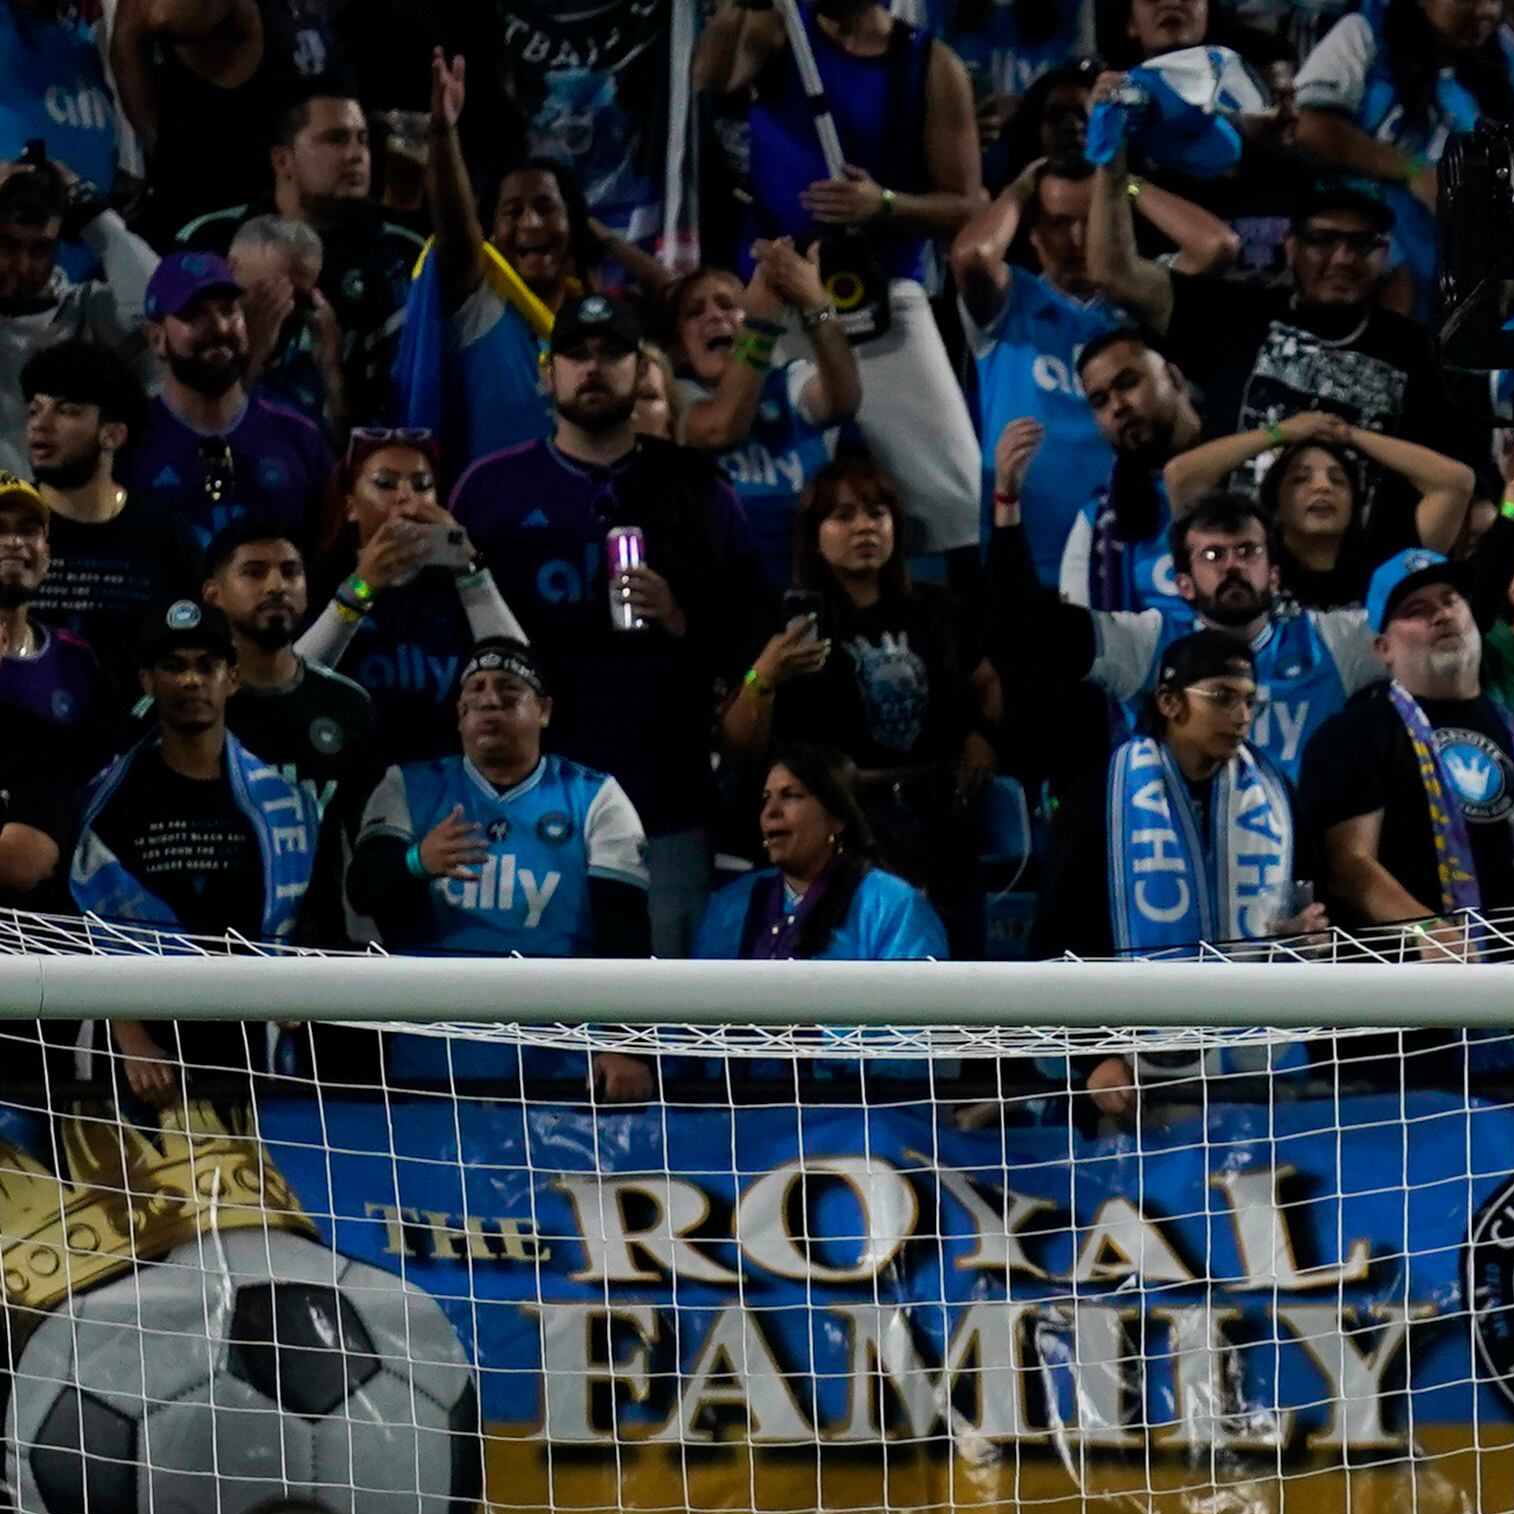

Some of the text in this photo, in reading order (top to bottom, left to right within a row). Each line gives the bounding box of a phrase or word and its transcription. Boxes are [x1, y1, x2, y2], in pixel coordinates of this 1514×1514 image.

[357, 642, 460, 706] ally
[433, 853, 563, 930] ally
[365, 1200, 552, 1261] THE
[553, 1149, 1373, 1295] ROYAL
[522, 1300, 1441, 1450] FAMILY
